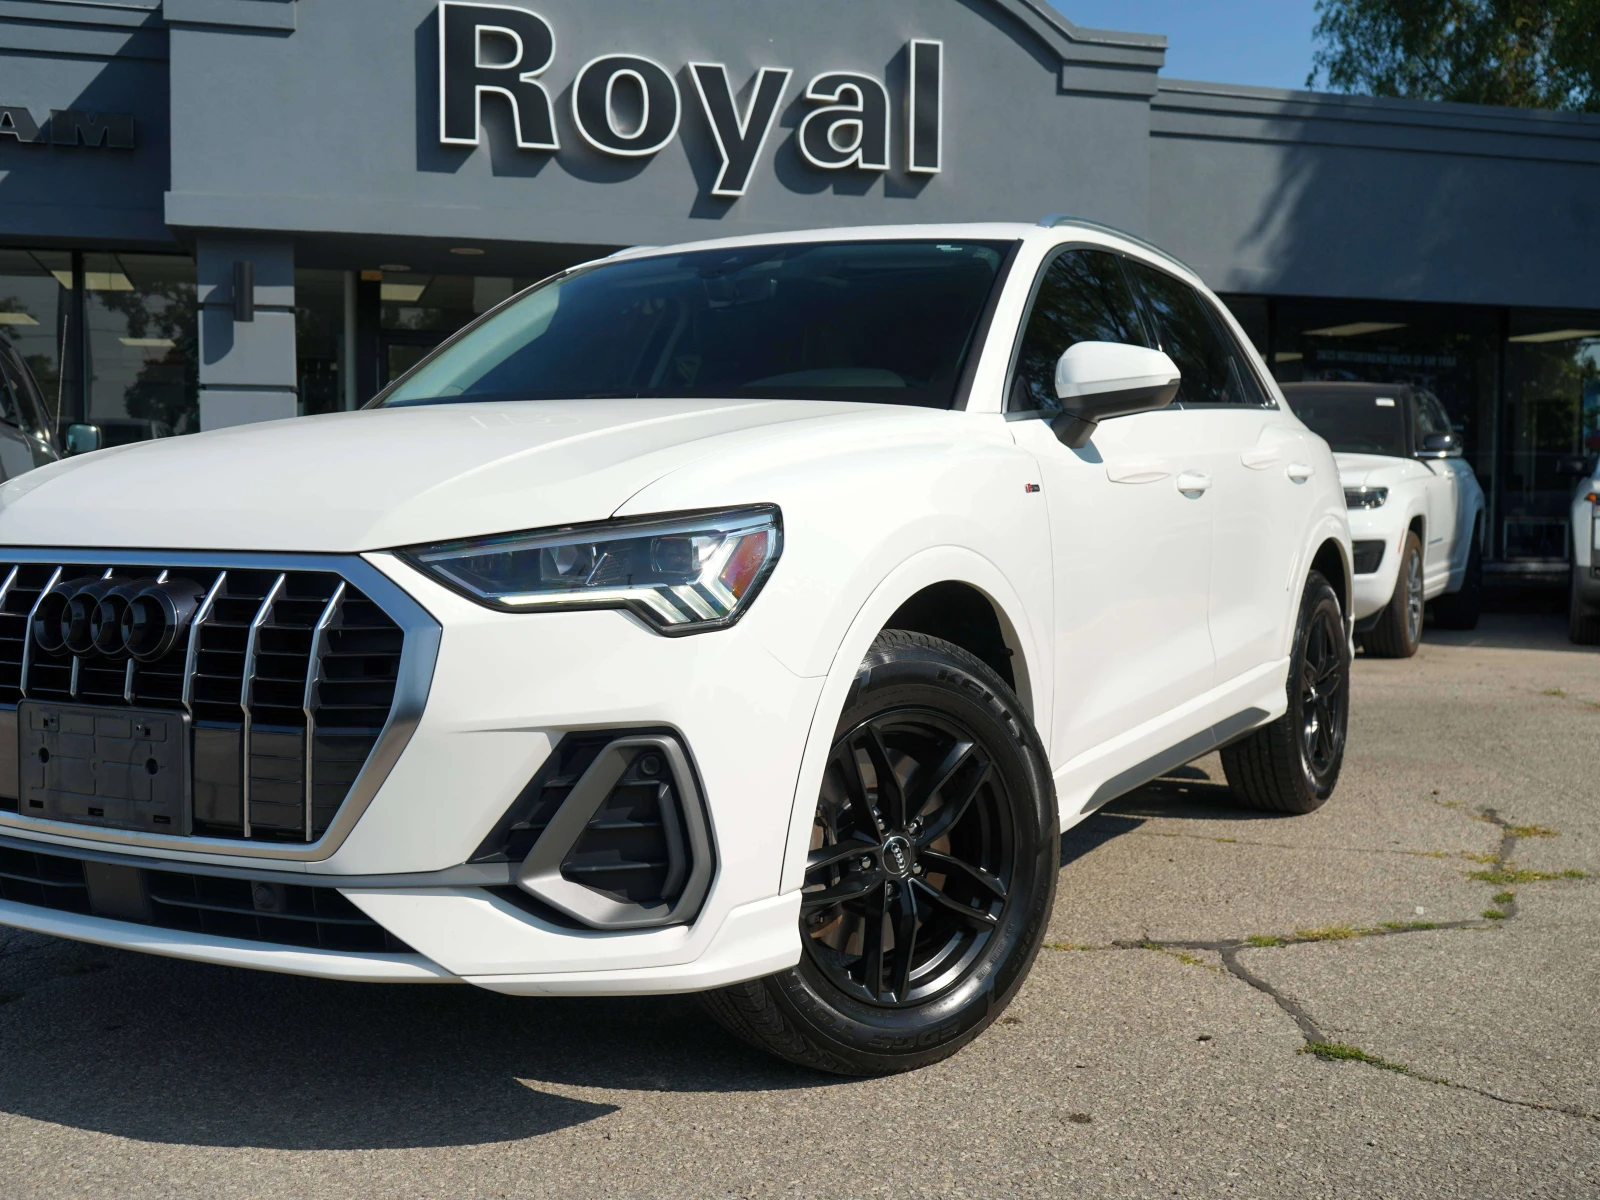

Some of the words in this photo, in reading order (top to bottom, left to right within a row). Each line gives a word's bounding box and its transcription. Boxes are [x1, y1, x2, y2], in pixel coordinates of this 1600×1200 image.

[438, 1, 943, 196] Royal
[936, 668, 1033, 751] KELLY
[868, 1018, 960, 1050] EDGE
